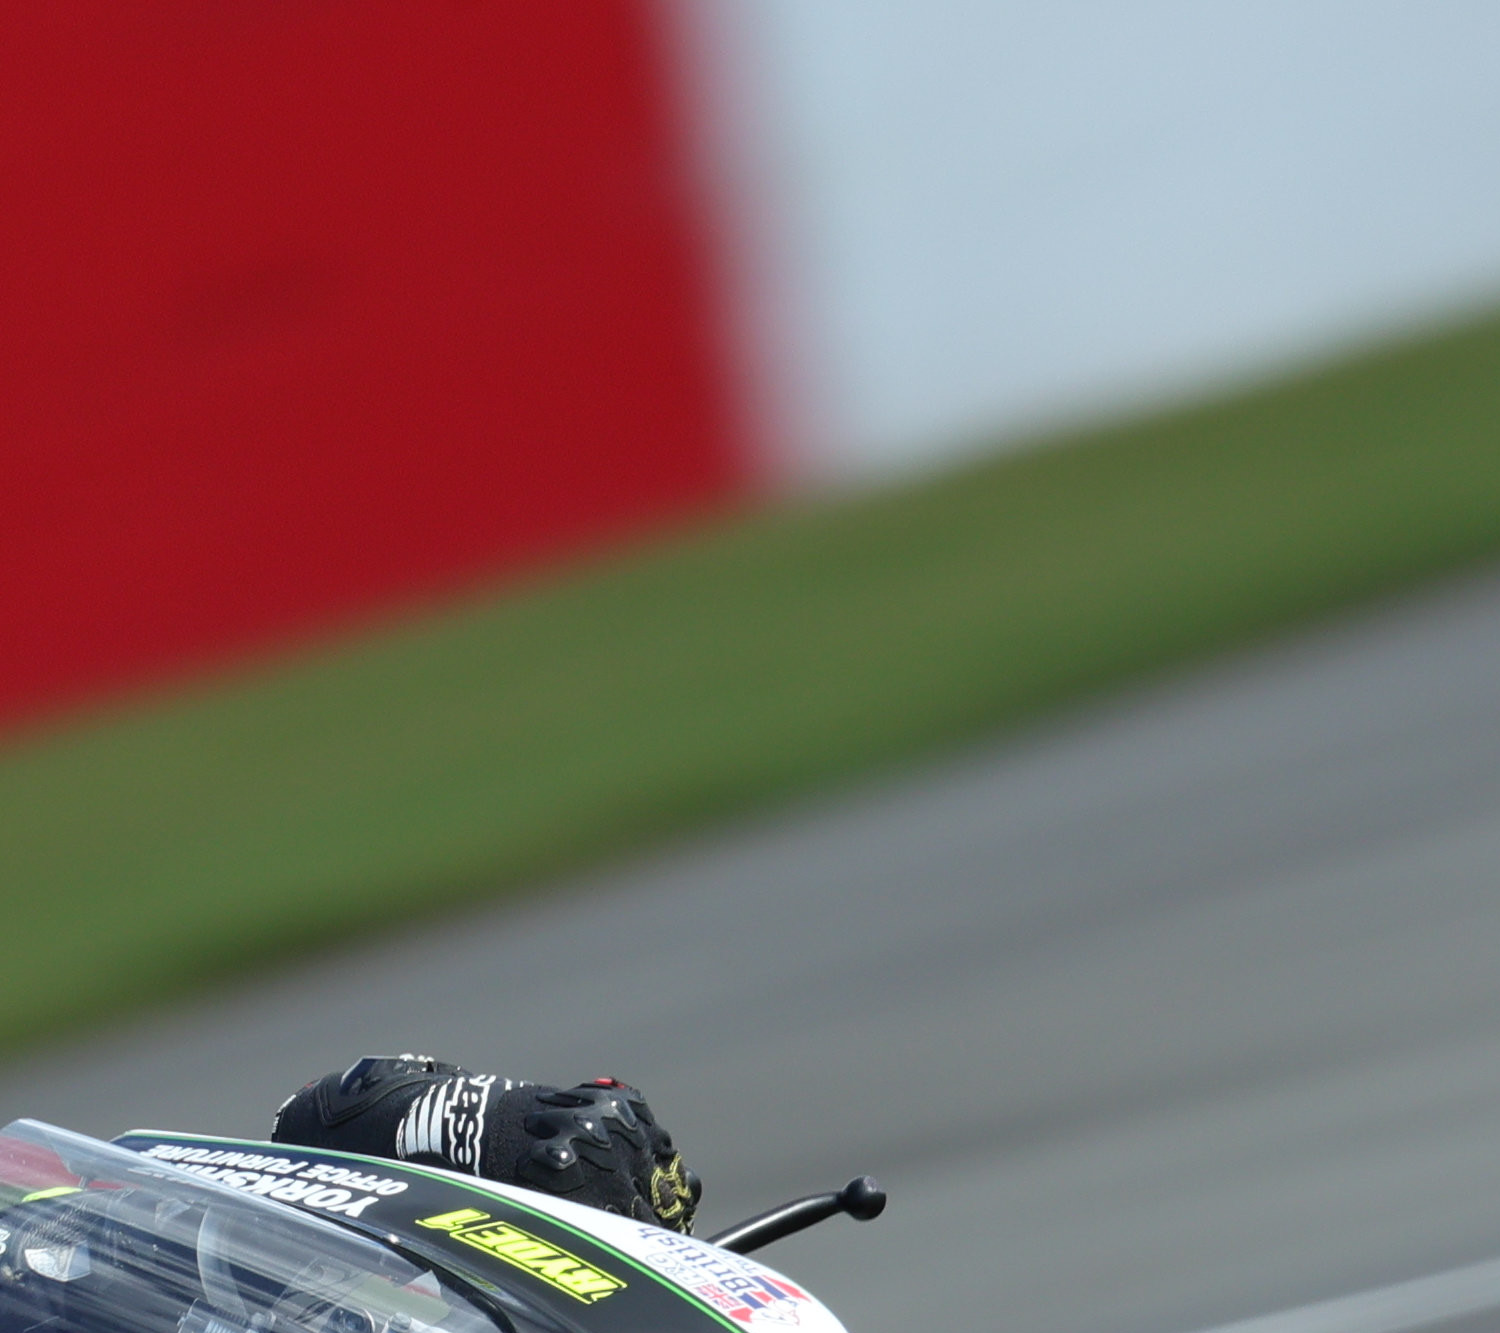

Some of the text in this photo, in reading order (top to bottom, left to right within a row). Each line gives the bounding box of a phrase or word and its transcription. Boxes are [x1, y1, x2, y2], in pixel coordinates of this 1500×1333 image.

[141, 1144, 409, 1196] OFFICE FURNITURE
[168, 1160, 379, 1218] YORKSH
[637, 1226, 756, 1294] British
